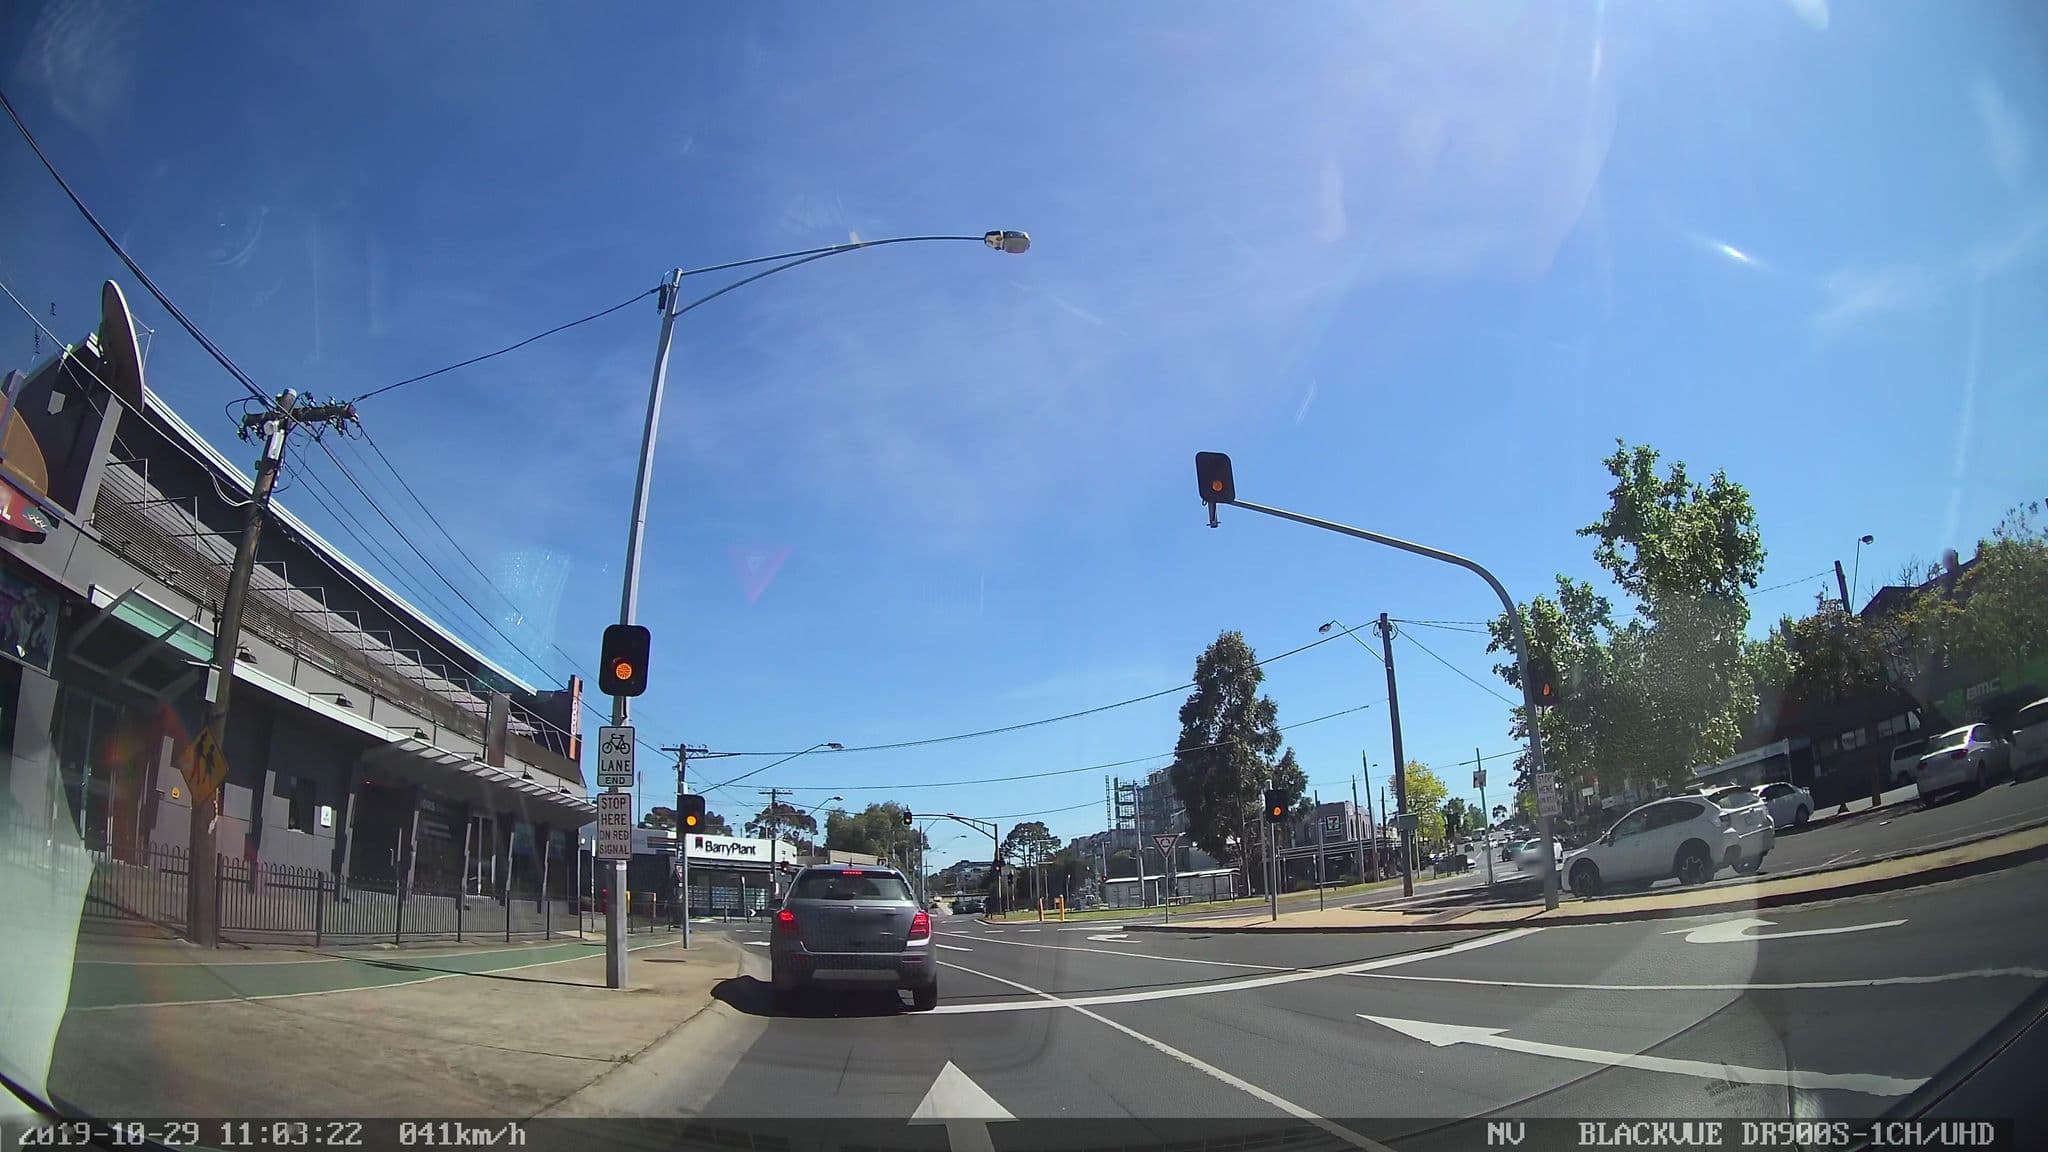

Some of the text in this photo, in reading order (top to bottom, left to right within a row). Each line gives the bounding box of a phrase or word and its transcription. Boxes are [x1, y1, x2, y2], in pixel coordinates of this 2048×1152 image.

[600, 759, 631, 772] LANE
[605, 776, 626, 785] END
[601, 797, 626, 810] STOP
[601, 813, 627, 826] HERE
[600, 830, 629, 841] ON RED
[599, 844, 630, 855] SIGNAL
